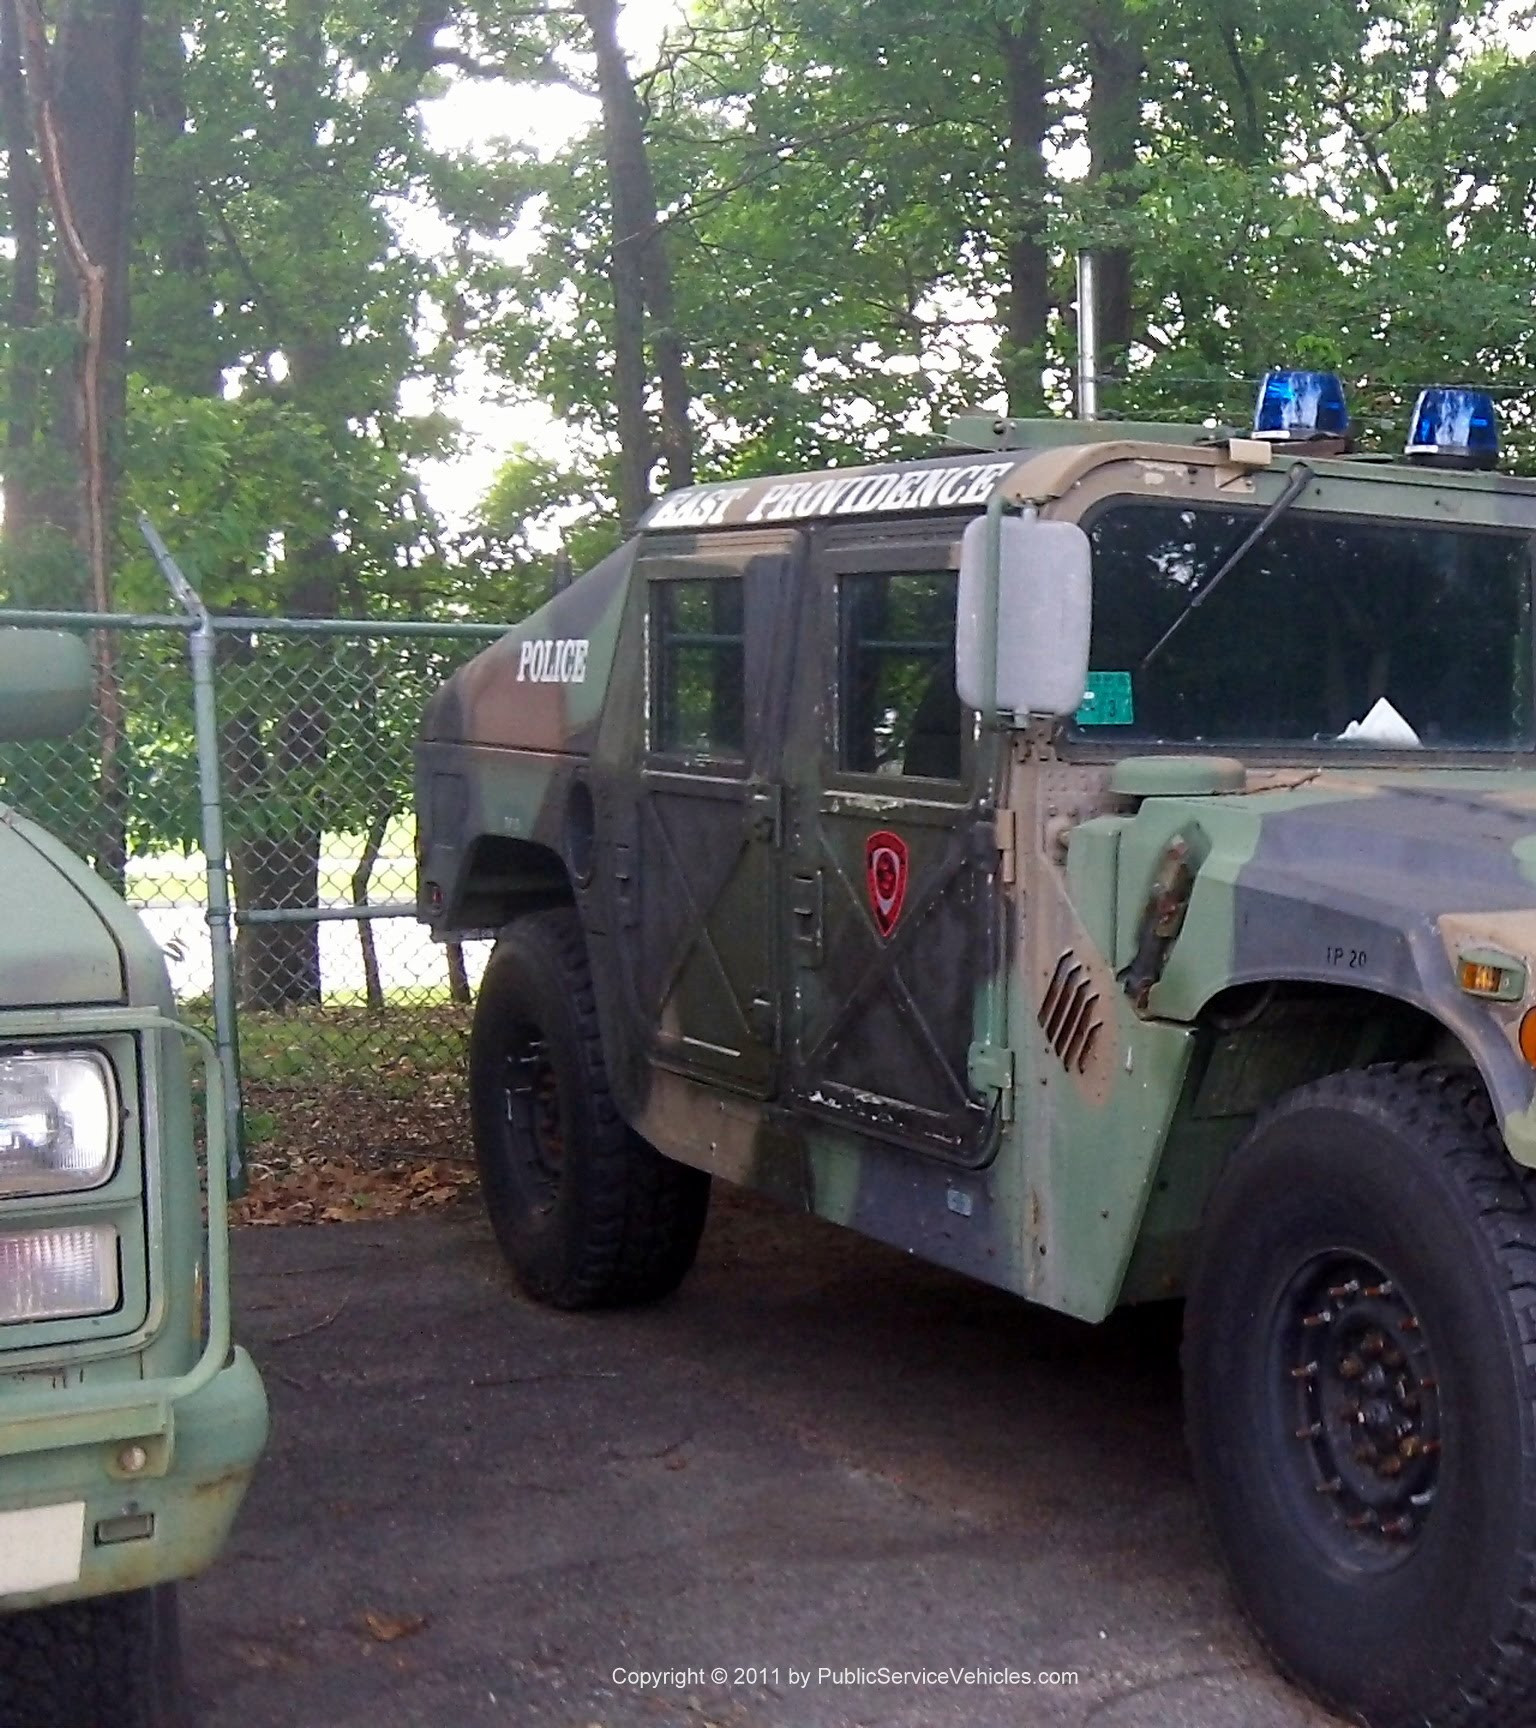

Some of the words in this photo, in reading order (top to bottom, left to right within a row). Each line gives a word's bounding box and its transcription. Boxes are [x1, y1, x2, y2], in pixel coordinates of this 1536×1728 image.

[648, 488, 750, 528] EAST
[746, 461, 1015, 522] PROVIDENCE
[516, 638, 590, 683] POLICE
[1349, 949, 1367, 968] 20
